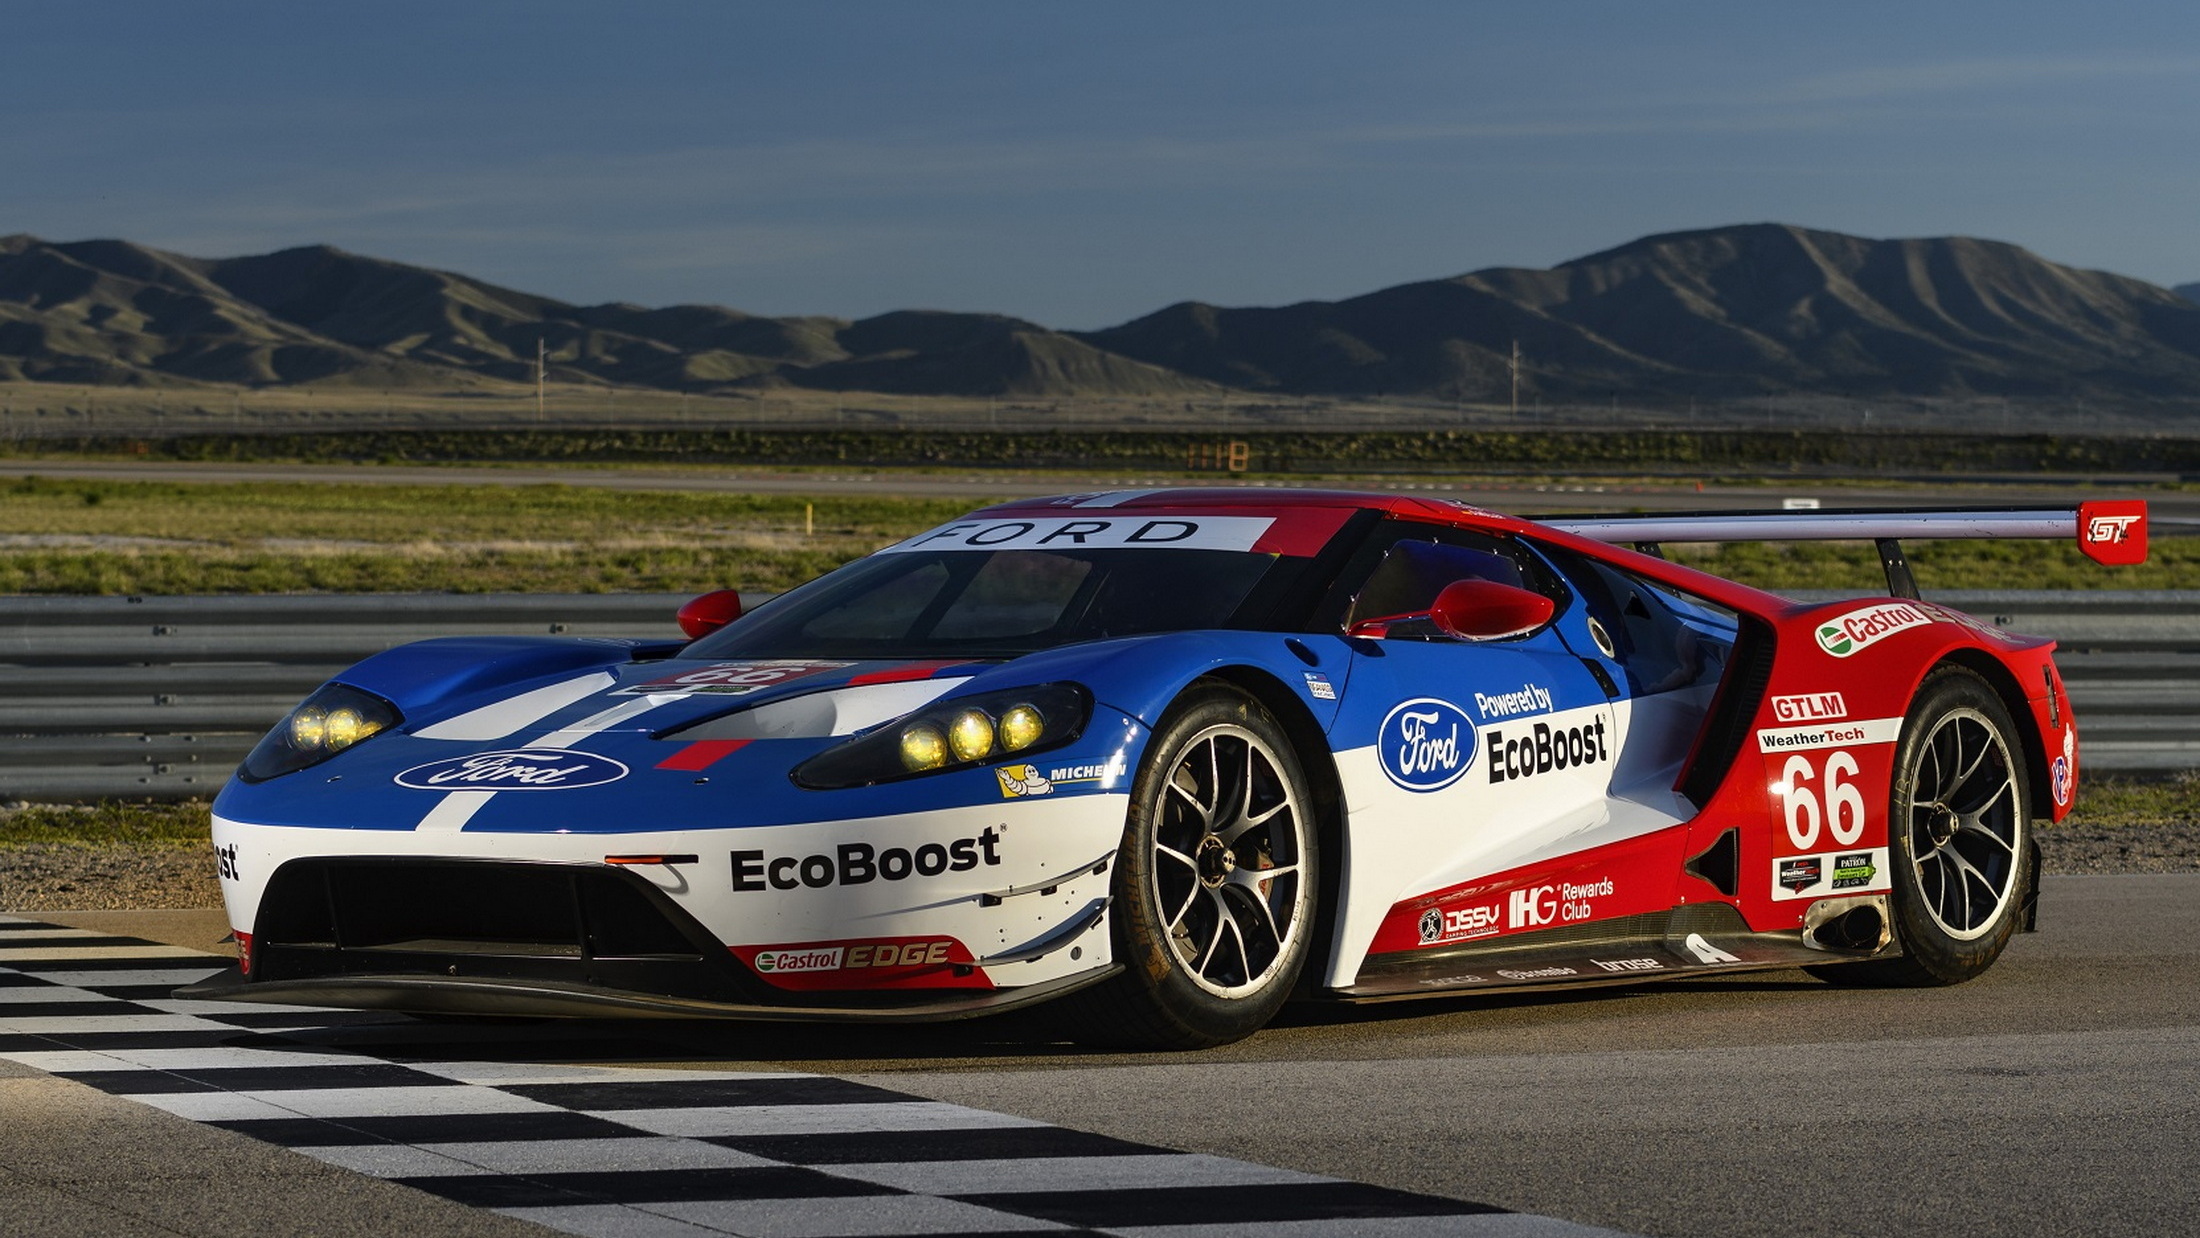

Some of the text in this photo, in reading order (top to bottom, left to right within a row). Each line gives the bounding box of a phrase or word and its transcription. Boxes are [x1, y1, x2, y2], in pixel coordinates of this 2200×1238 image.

[911, 520, 1200, 548] FORD
[1843, 605, 1924, 643] Castrol
[1474, 683, 1553, 720] Powered by
[1775, 694, 1844, 720] GTLM
[1400, 711, 1460, 776] Ford
[1486, 713, 1607, 785] EcoBoost
[1762, 727, 1865, 748] WeatherTech
[427, 752, 590, 784] Ford
[1782, 750, 1866, 851] 66
[730, 825, 1002, 893] EcoBoost
[1561, 876, 1614, 901] Rewards
[1445, 903, 1500, 933] DSSV
[1561, 899, 1592, 921] Club
[776, 941, 953, 971] Castrol EDGE
[1589, 957, 1665, 972] brose
